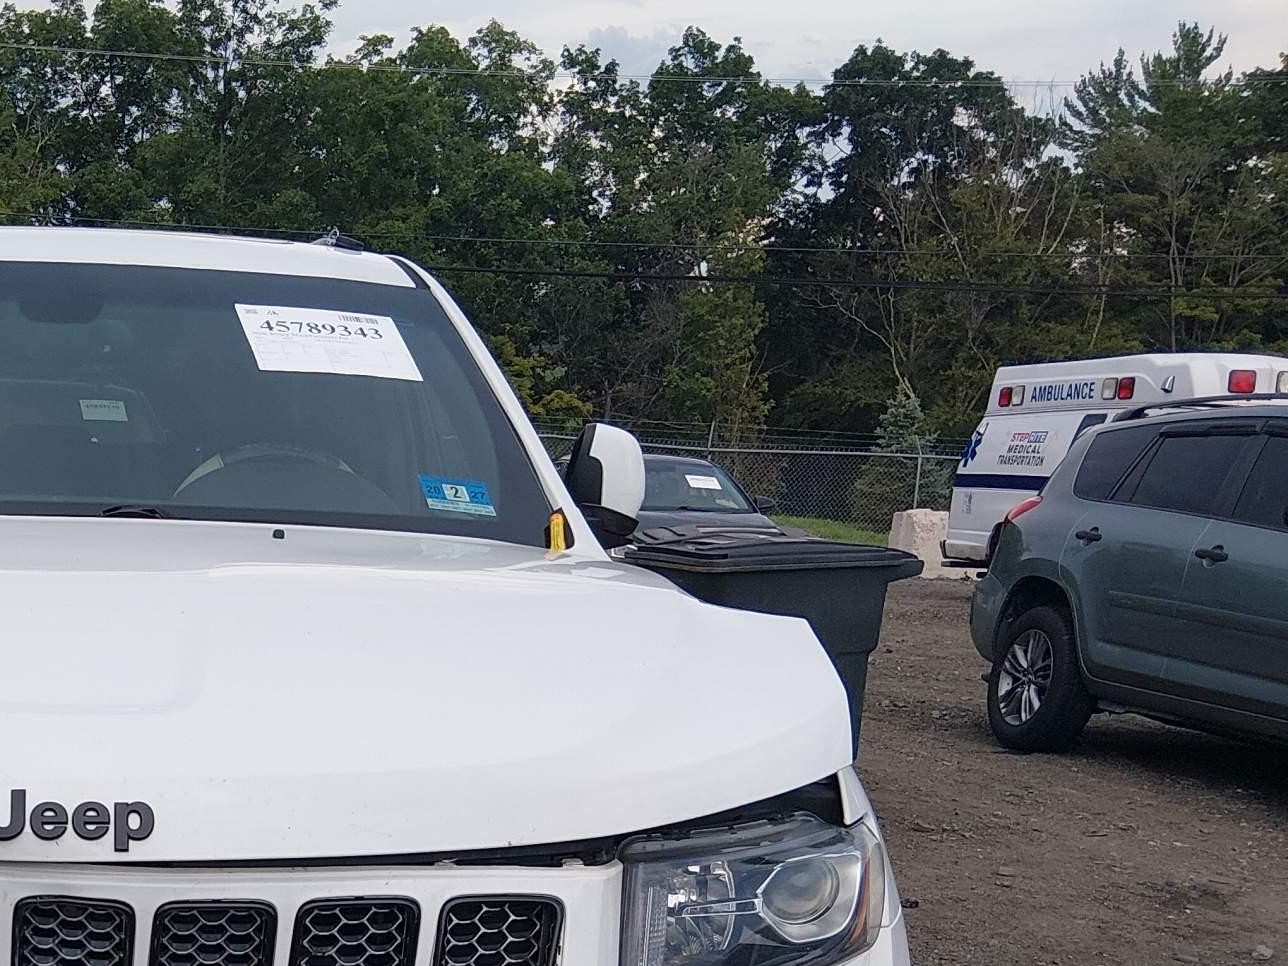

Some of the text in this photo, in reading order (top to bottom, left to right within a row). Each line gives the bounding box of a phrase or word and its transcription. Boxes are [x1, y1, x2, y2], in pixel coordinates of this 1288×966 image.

[259, 319, 384, 340] 45789343
[1030, 382, 1095, 403] AMBULANCE
[1007, 444, 1041, 454] MEDICAL
[997, 455, 1045, 467] TRANSPORTATION
[426, 485, 486, 499] 20 2 27
